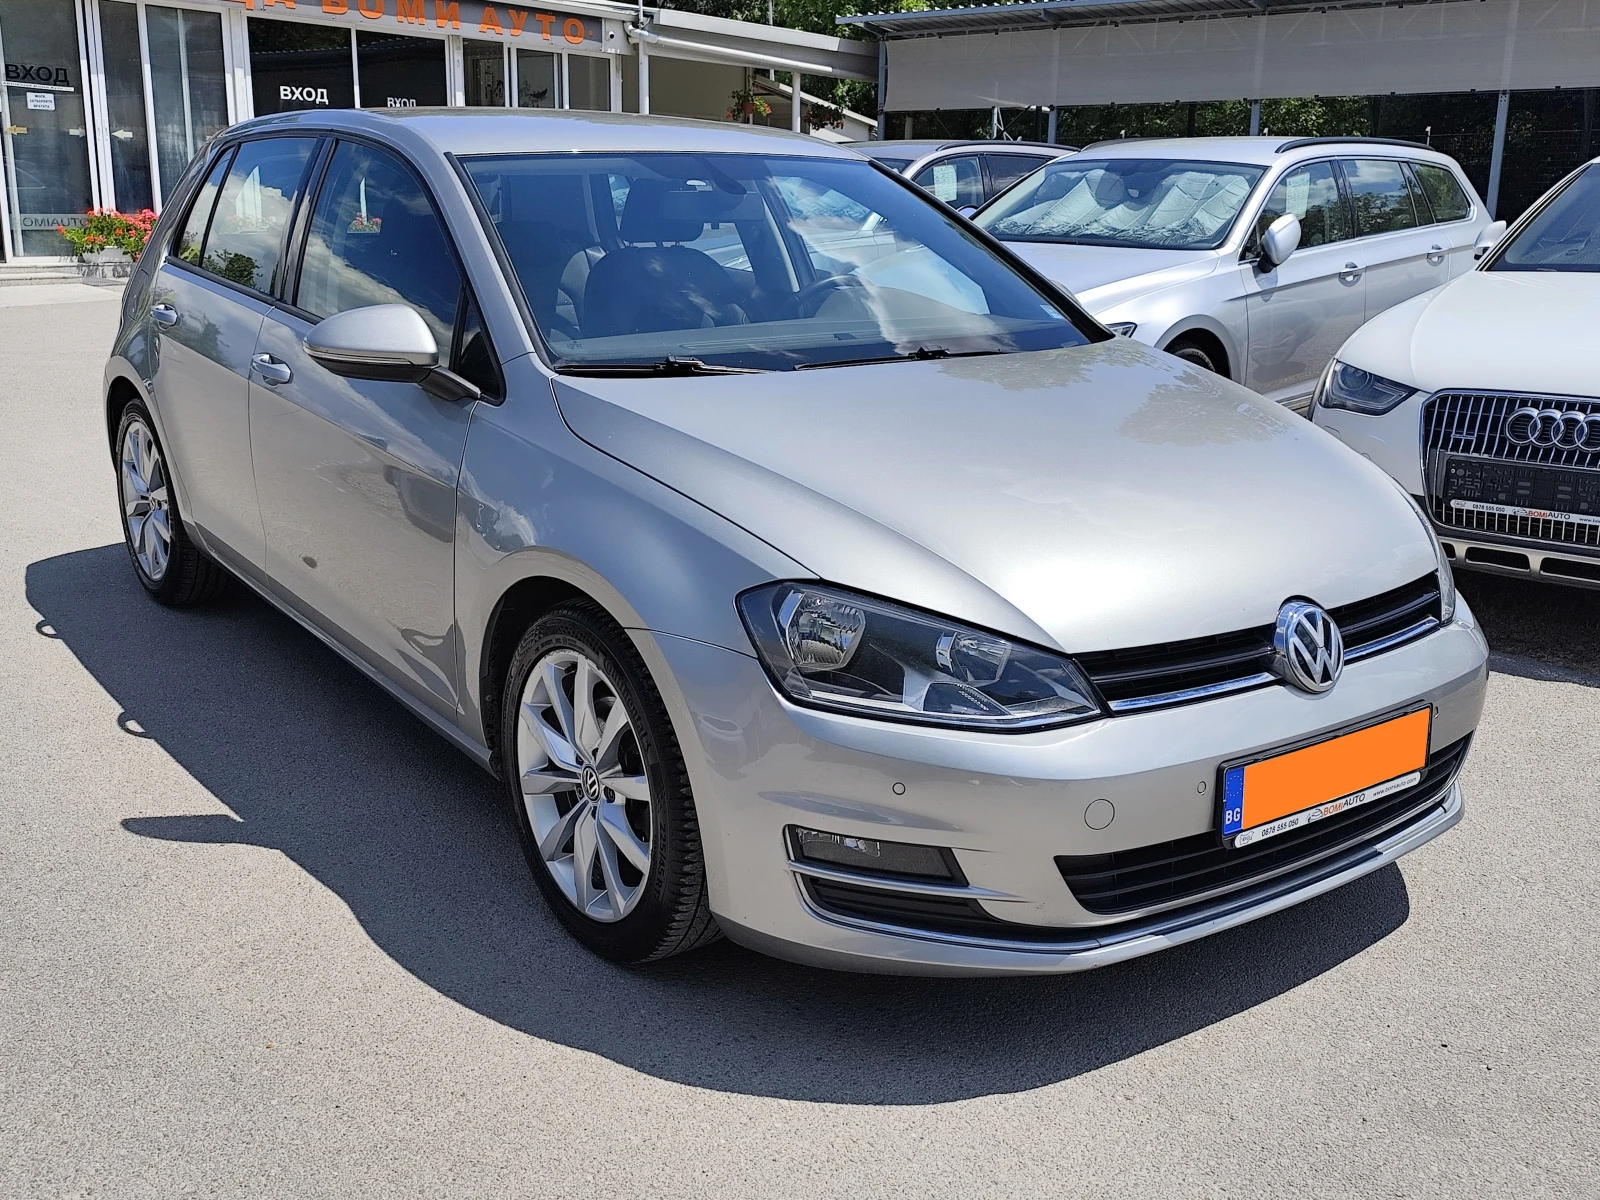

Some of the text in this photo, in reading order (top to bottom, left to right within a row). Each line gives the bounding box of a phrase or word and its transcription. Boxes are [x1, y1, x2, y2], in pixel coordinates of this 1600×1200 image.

[479, 6, 585, 44] АУТО
[5, 63, 70, 86] ВХОД
[279, 85, 329, 105] ВХОД
[1323, 793, 1366, 816] BOMIAUTO
[1225, 807, 1241, 825] BG
[1261, 818, 1299, 837] 0878 555 050
